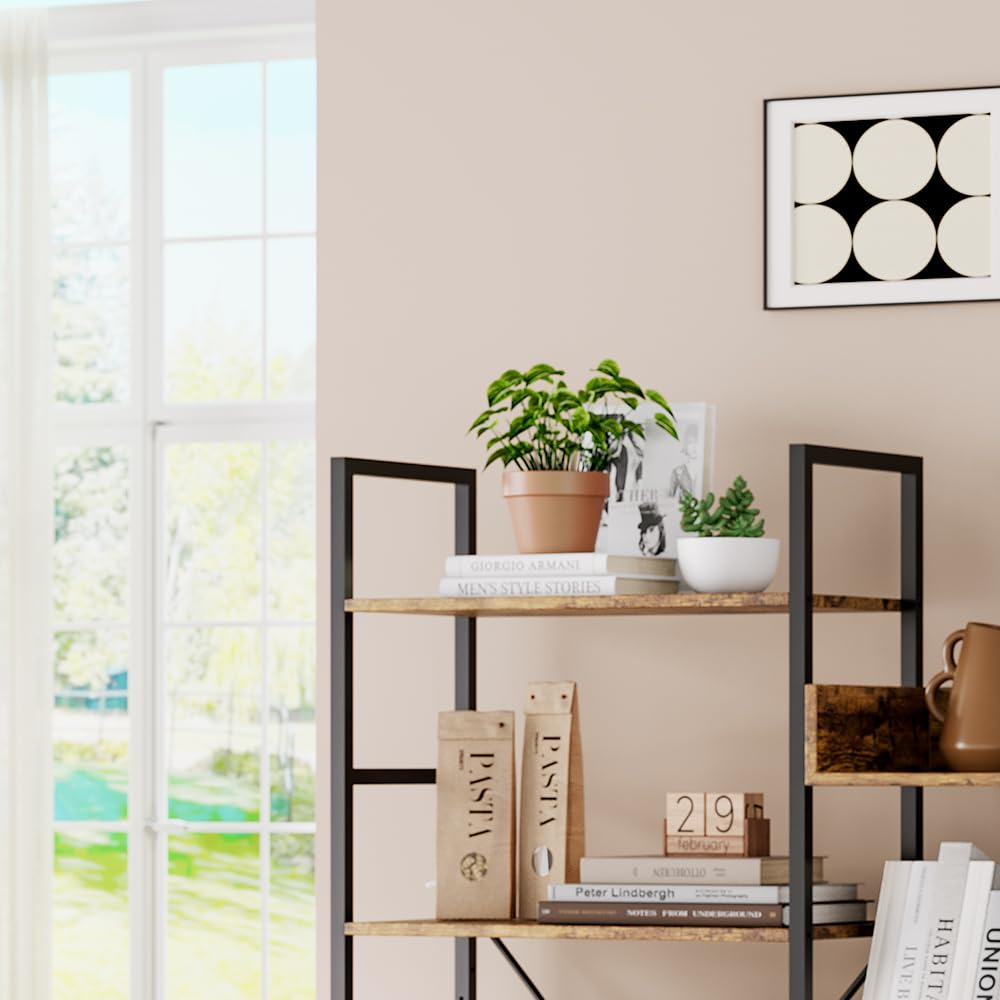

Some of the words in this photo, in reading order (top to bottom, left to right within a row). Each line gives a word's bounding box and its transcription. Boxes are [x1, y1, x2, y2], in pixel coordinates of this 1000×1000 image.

[470, 560, 525, 573] GIORGIO
[529, 559, 581, 571] ARMANI
[457, 582, 499, 596] MEN'S
[502, 581, 545, 595] STYLE
[546, 580, 601, 594] STORIES
[539, 736, 561, 827] PASTA
[468, 752, 495, 838] PASTA
[677, 837, 731, 853] february
[575, 886, 607, 899] Peter
[612, 886, 675, 901] Lindbergh
[627, 908, 657, 918] NOTES
[662, 909, 688, 918] FROM
[693, 909, 762, 919] UNDERGROUND
